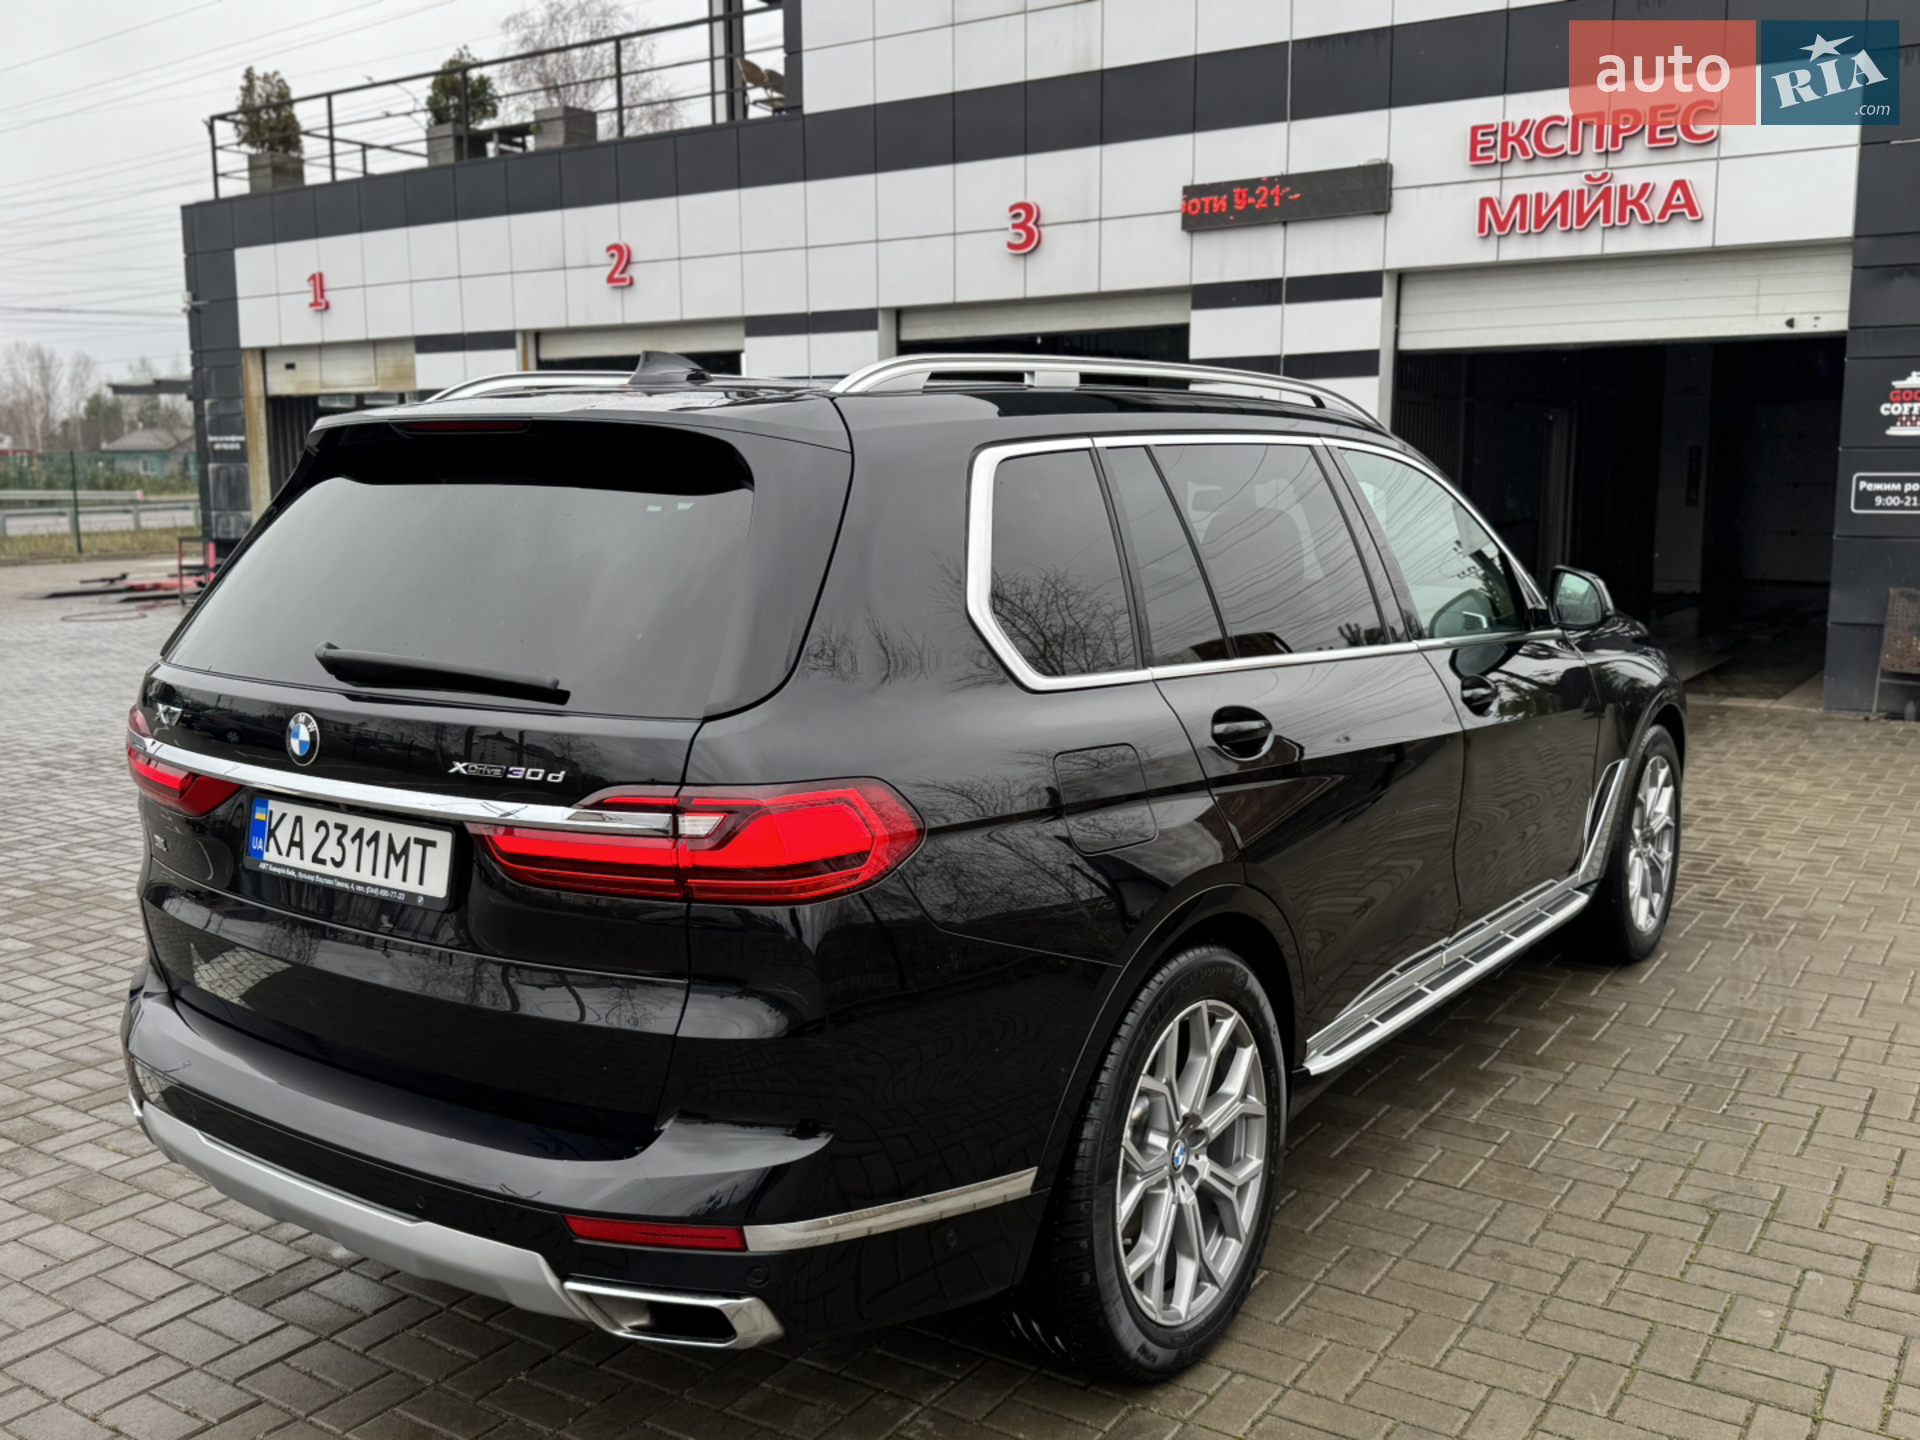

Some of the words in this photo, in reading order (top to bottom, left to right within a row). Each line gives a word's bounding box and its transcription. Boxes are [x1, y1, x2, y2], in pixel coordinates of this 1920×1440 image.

[1467, 98, 1720, 165] ЕКСПРЕС
[1476, 170, 1704, 237] МИЙКА
[1006, 201, 1041, 255] 3
[605, 242, 634, 289] 2
[306, 271, 330, 311] 1
[1859, 480, 1902, 492] Режим
[155, 703, 184, 726] X7
[252, 836, 263, 851] UA
